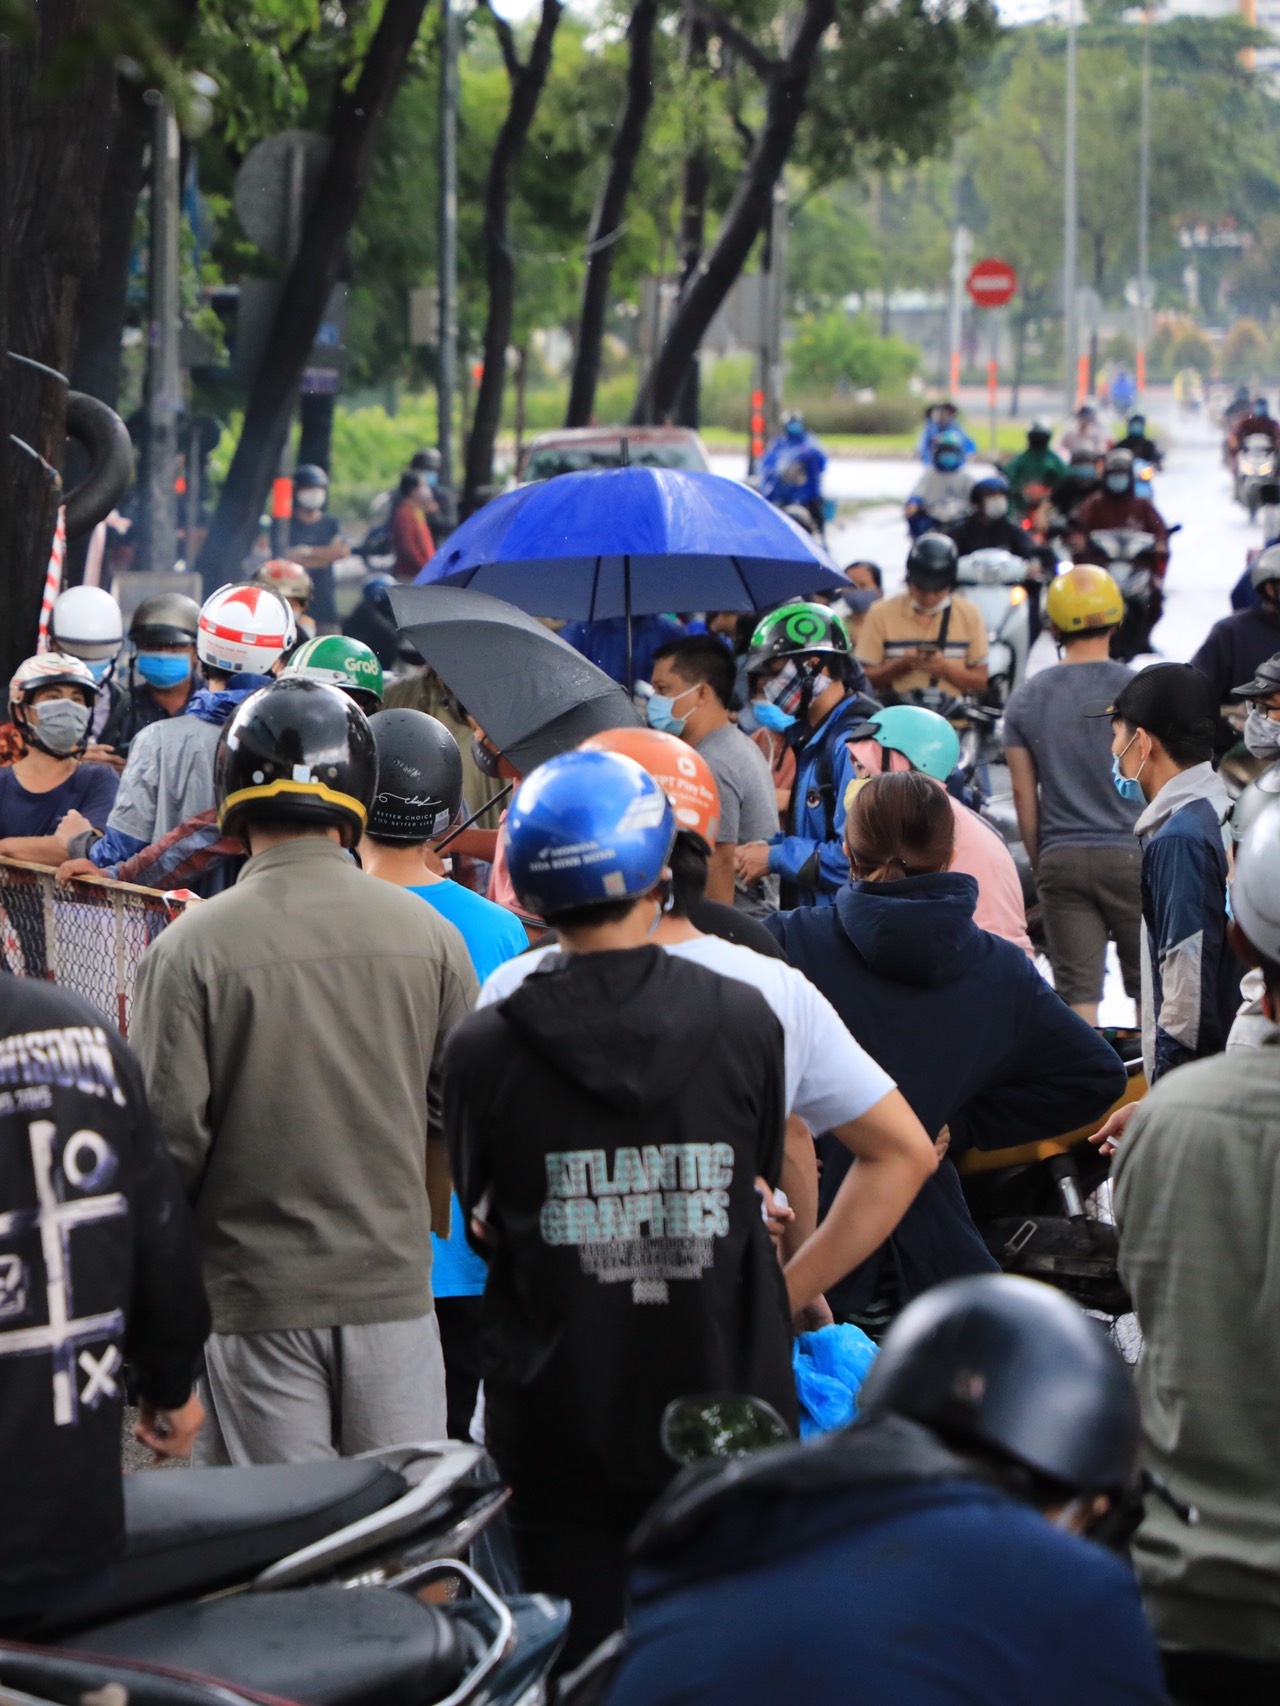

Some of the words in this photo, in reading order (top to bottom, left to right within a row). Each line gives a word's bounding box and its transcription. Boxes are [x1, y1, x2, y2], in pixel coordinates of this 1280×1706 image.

[344, 657, 379, 676] Grab
[376, 810, 401, 820] BETTER
[405, 813, 433, 821] CHOICE
[545, 1142, 735, 1199] ATLANTIC
[539, 1189, 730, 1246] GRAPHICS
